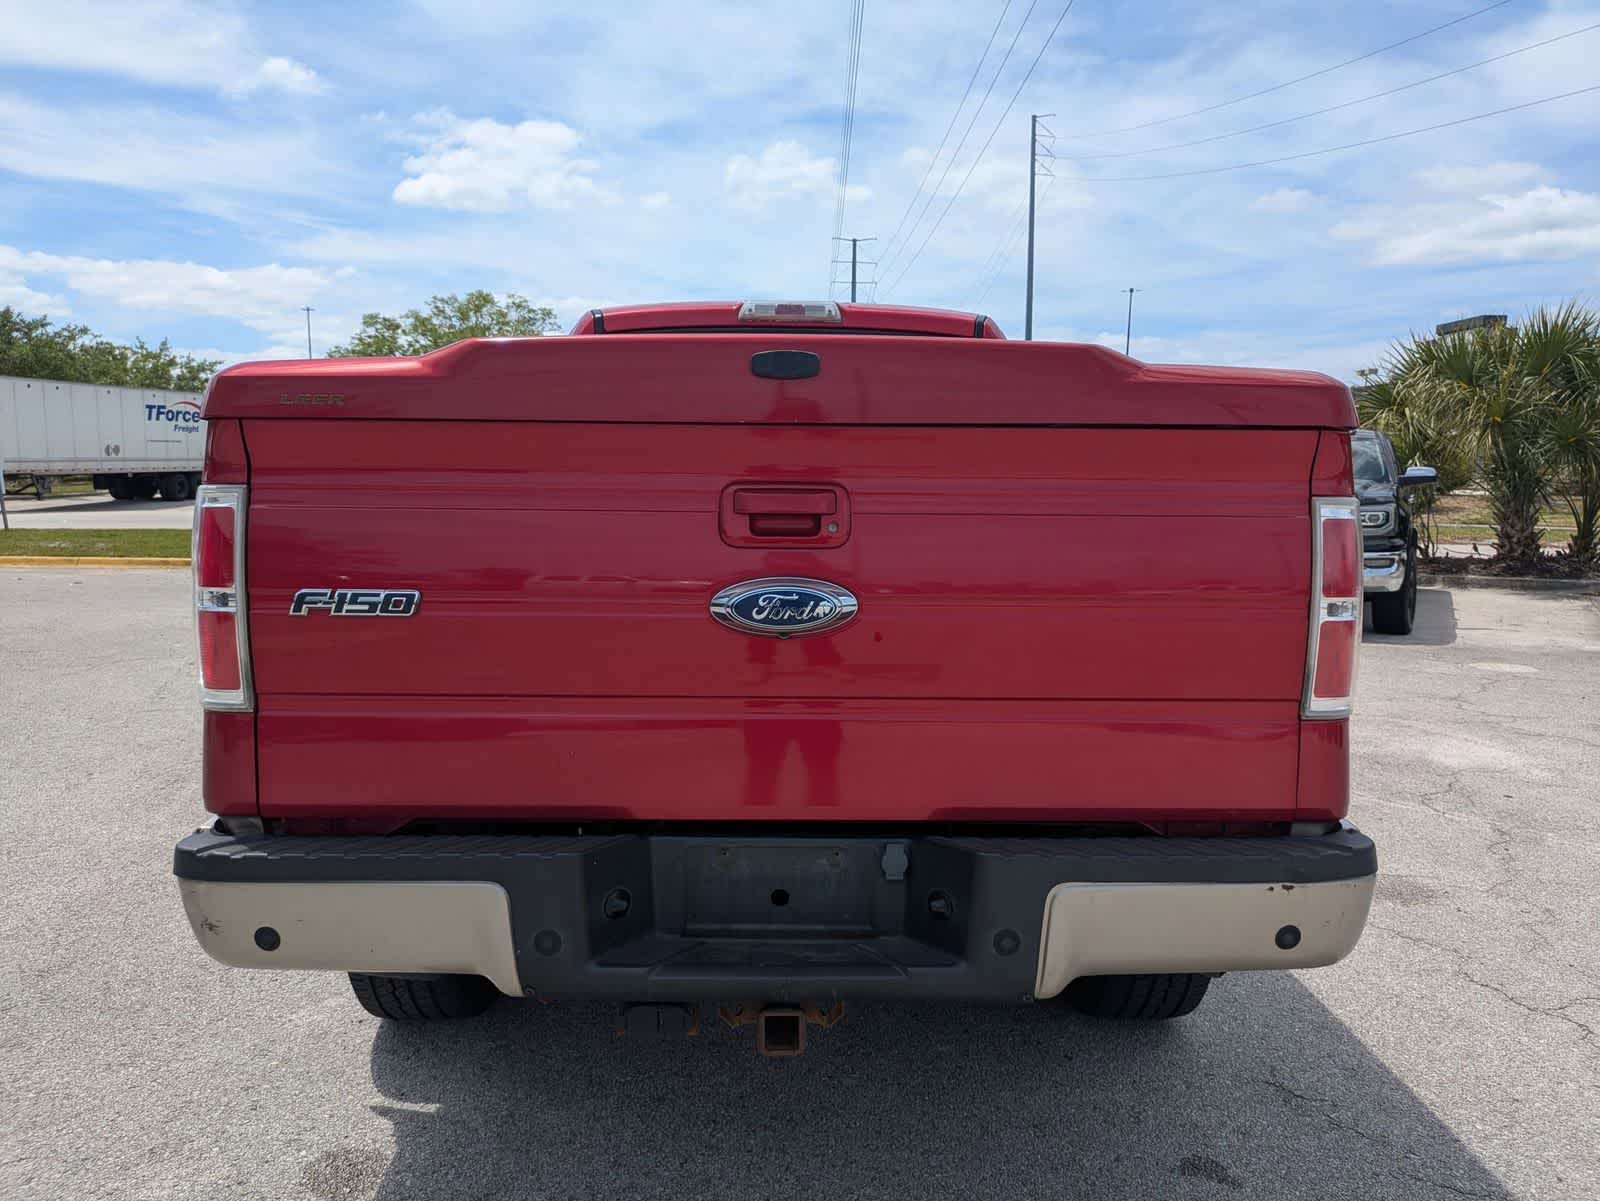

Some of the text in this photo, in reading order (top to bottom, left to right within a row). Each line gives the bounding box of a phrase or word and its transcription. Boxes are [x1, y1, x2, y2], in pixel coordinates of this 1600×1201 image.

[145, 403, 200, 422] TForce
[173, 424, 199, 433] Freight
[751, 593, 817, 619] Ford
